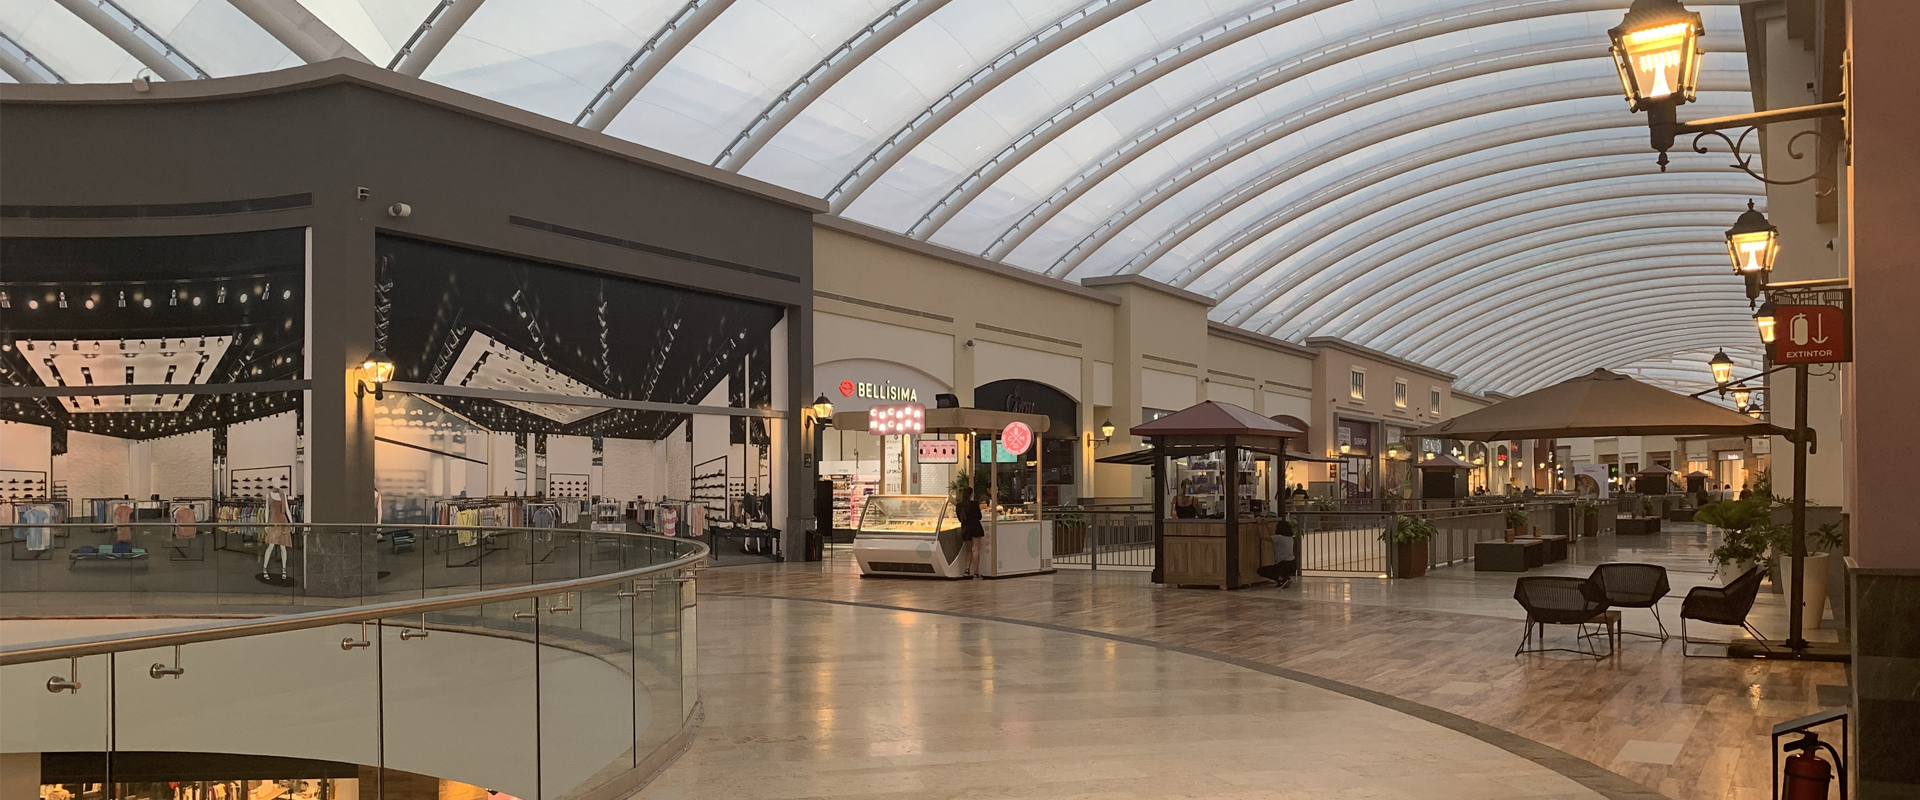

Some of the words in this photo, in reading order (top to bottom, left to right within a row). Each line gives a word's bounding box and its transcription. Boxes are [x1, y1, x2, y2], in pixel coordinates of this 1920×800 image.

[1786, 349, 1833, 358] EXTINTOR
[858, 380, 917, 402] BELLÍSIMA
[869, 407, 921, 419] CUCARA
[869, 420, 921, 432] MACARA
